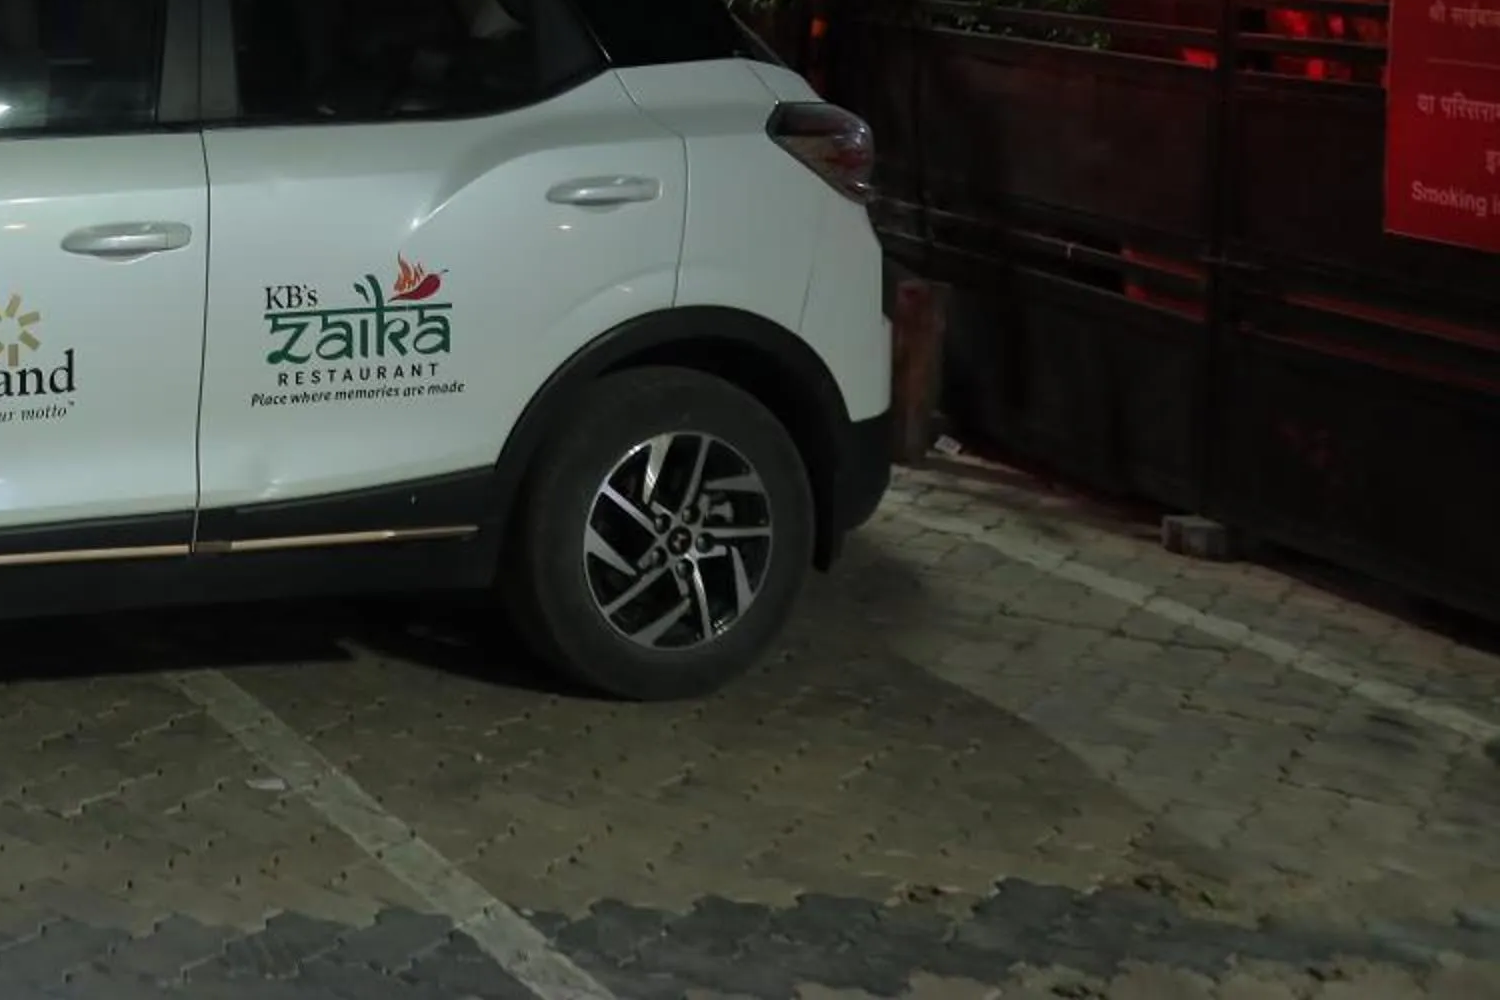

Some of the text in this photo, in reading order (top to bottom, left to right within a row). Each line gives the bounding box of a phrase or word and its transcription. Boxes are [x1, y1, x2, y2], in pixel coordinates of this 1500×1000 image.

[1411, 180, 1488, 217] Smoking
[264, 285, 318, 310] KB's
[278, 363, 439, 386] RESTAURANT
[251, 380, 466, 407] Place where memories are made
